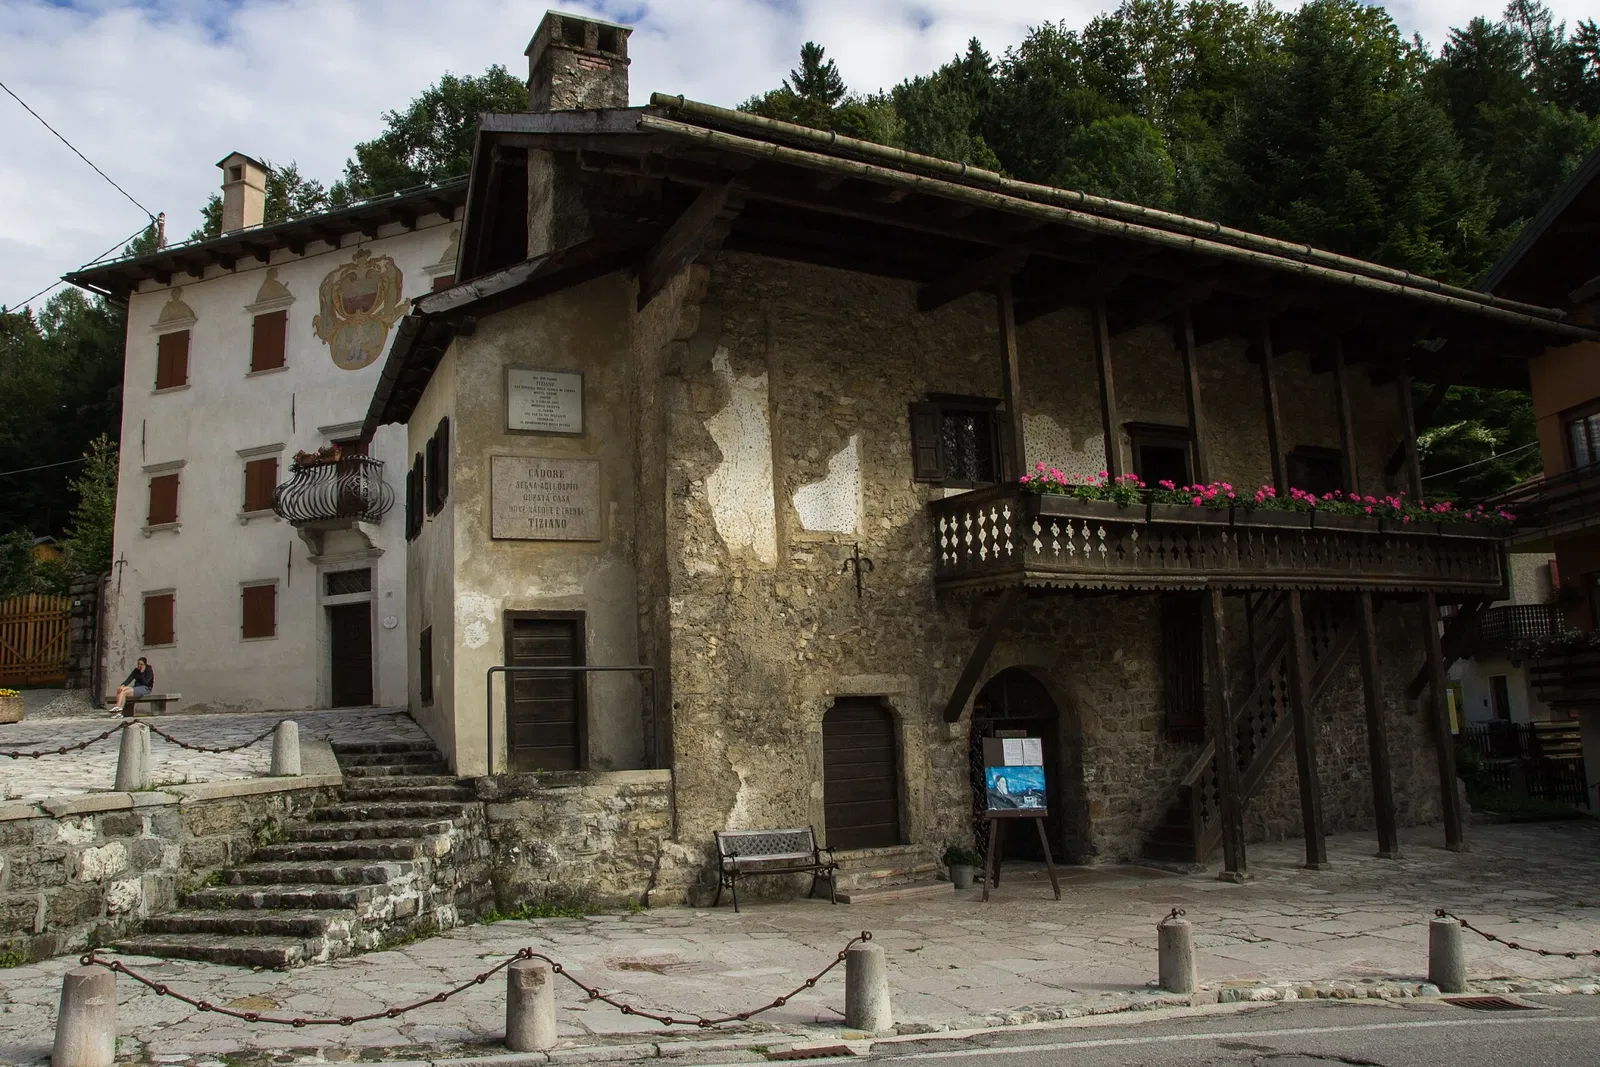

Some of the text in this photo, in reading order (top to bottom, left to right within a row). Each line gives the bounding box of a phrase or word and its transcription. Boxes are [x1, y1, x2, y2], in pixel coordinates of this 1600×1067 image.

[528, 468, 565, 478] CADORE
[523, 494, 570, 503] QUESTA CASA
[527, 518, 567, 529] TIZIANO
